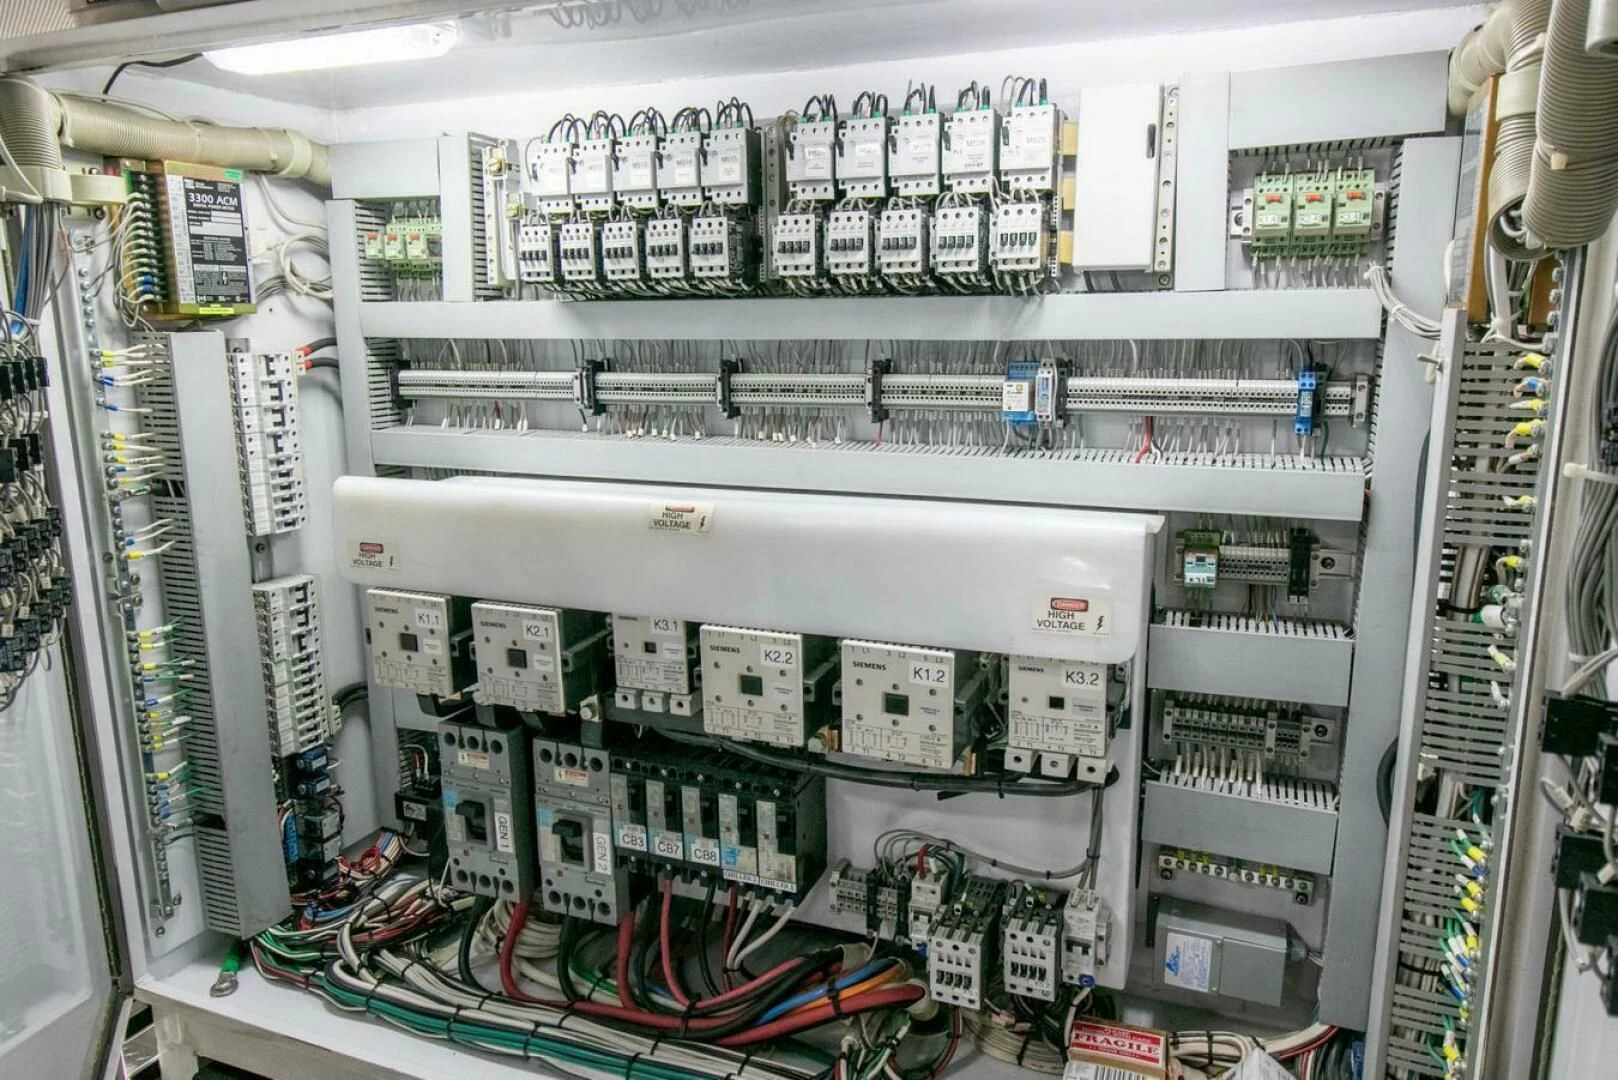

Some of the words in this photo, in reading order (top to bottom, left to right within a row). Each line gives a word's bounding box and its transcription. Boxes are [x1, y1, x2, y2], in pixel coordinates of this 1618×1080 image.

[187, 192, 213, 204] 3300
[216, 195, 238, 207] ACM
[662, 511, 683, 520] HIGH
[653, 518, 692, 529] VOLTAGE
[352, 559, 384, 568] VOLTAGE
[374, 606, 400, 615] SIEMENS
[1047, 610, 1075, 620] HIGH
[417, 612, 440, 626] K1.1
[479, 620, 507, 629] SIEMENS
[653, 618, 678, 632] K3.1
[1036, 618, 1087, 631] VOLTAGE
[525, 624, 550, 639] K2.1
[709, 644, 741, 654] SIEMENS
[764, 650, 793, 665] K2.2
[852, 661, 887, 671] SIEMENS
[1018, 665, 1045, 673] SIEMENS
[913, 667, 945, 683] K1.2
[1065, 669, 1099, 686] K3.2
[498, 815, 509, 840] GEN
[622, 833, 644, 848] CB3
[657, 840, 681, 855] CB7
[596, 836, 608, 861] GEN
[693, 848, 717, 863] CB8
[597, 862, 608, 872] 2
[1074, 1033, 1161, 1056] FRAGILE
